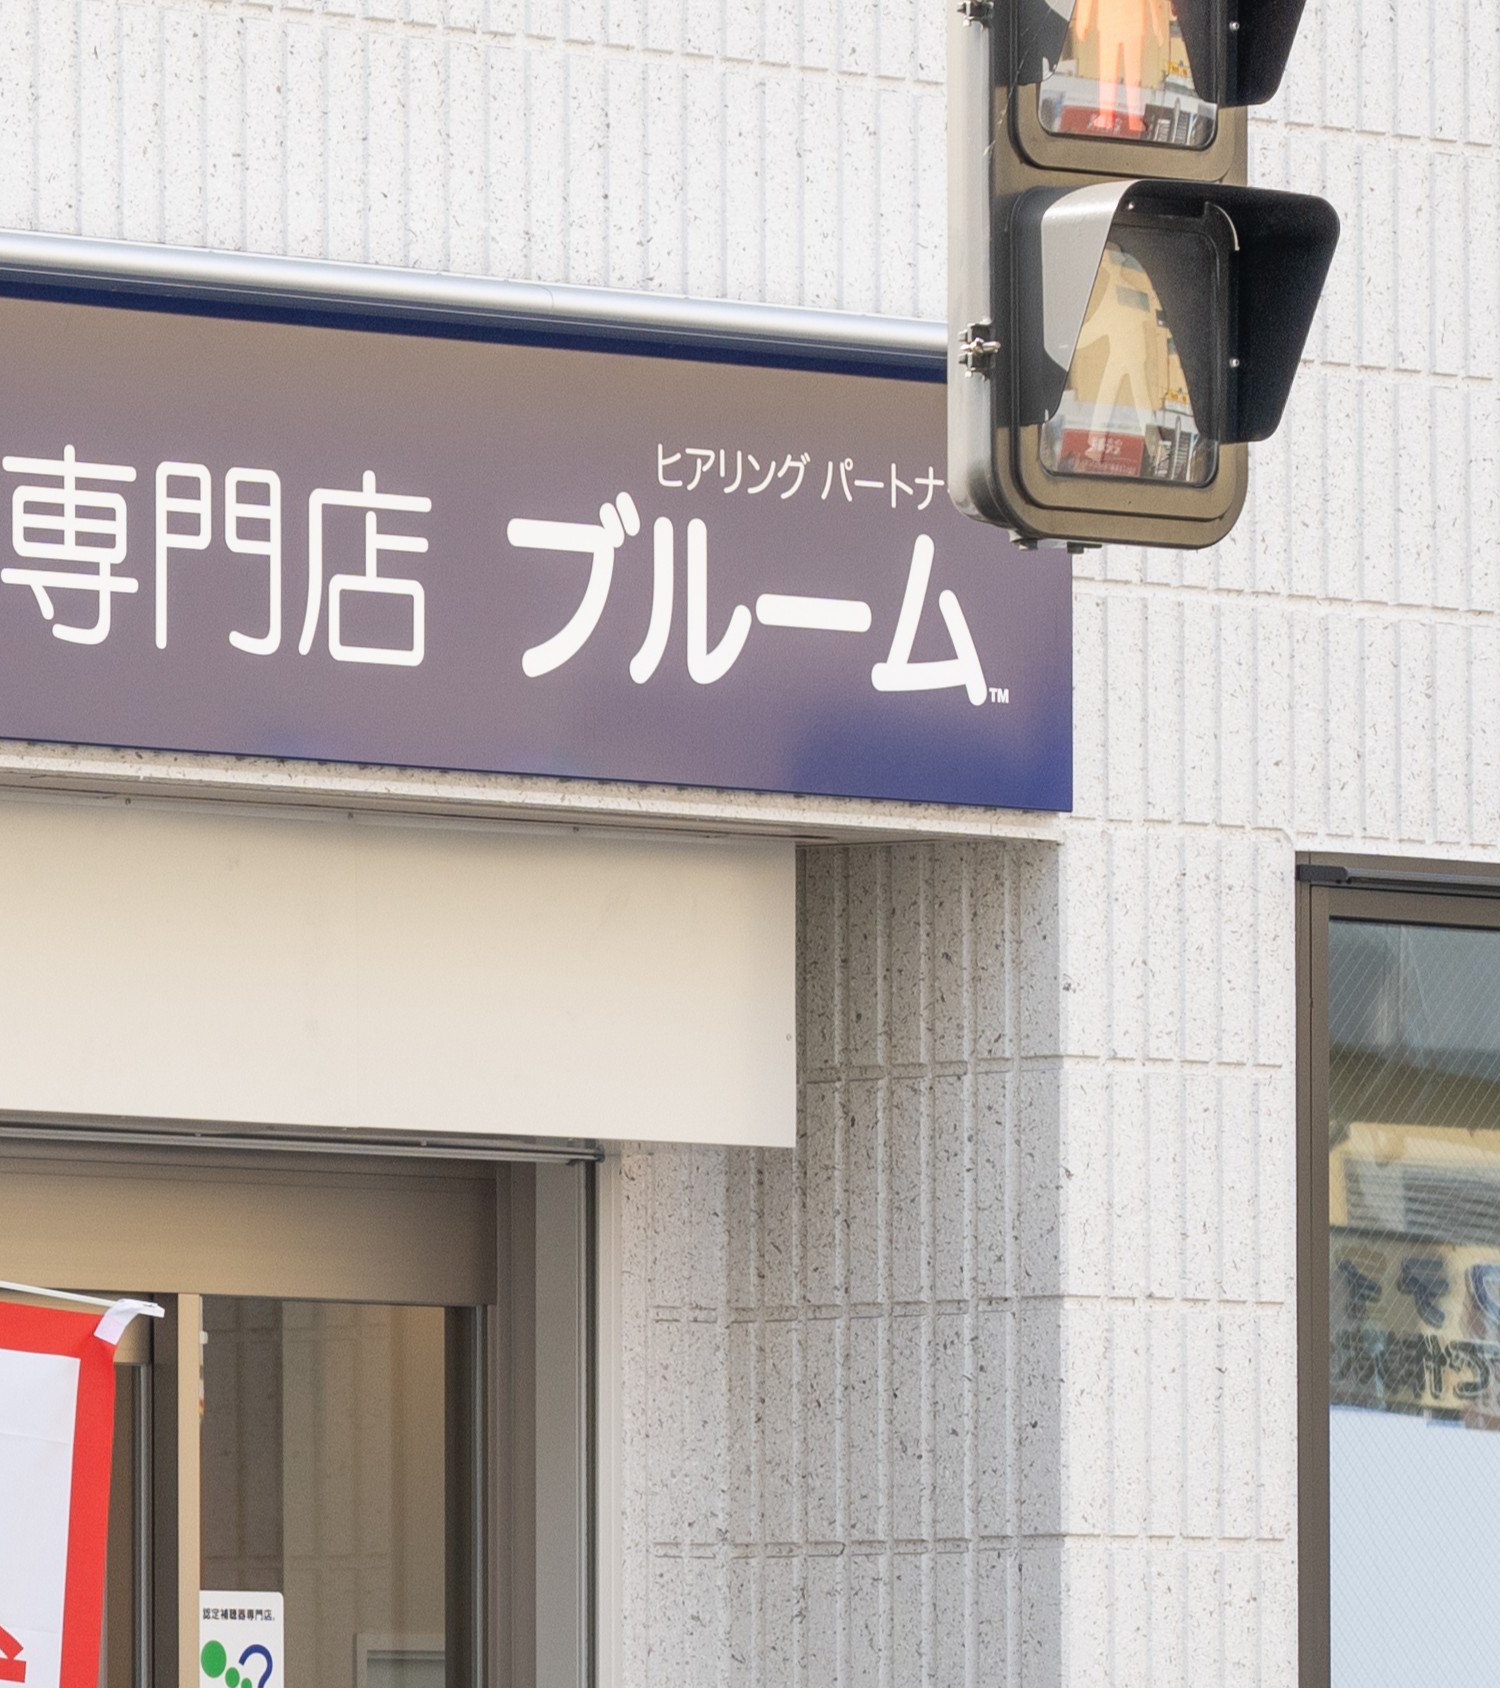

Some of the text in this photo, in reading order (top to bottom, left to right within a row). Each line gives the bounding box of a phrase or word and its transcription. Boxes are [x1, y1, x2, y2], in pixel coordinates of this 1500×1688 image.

[657, 443, 950, 511] ヒアリング パートナ
[507, 491, 987, 706] ブルーム
